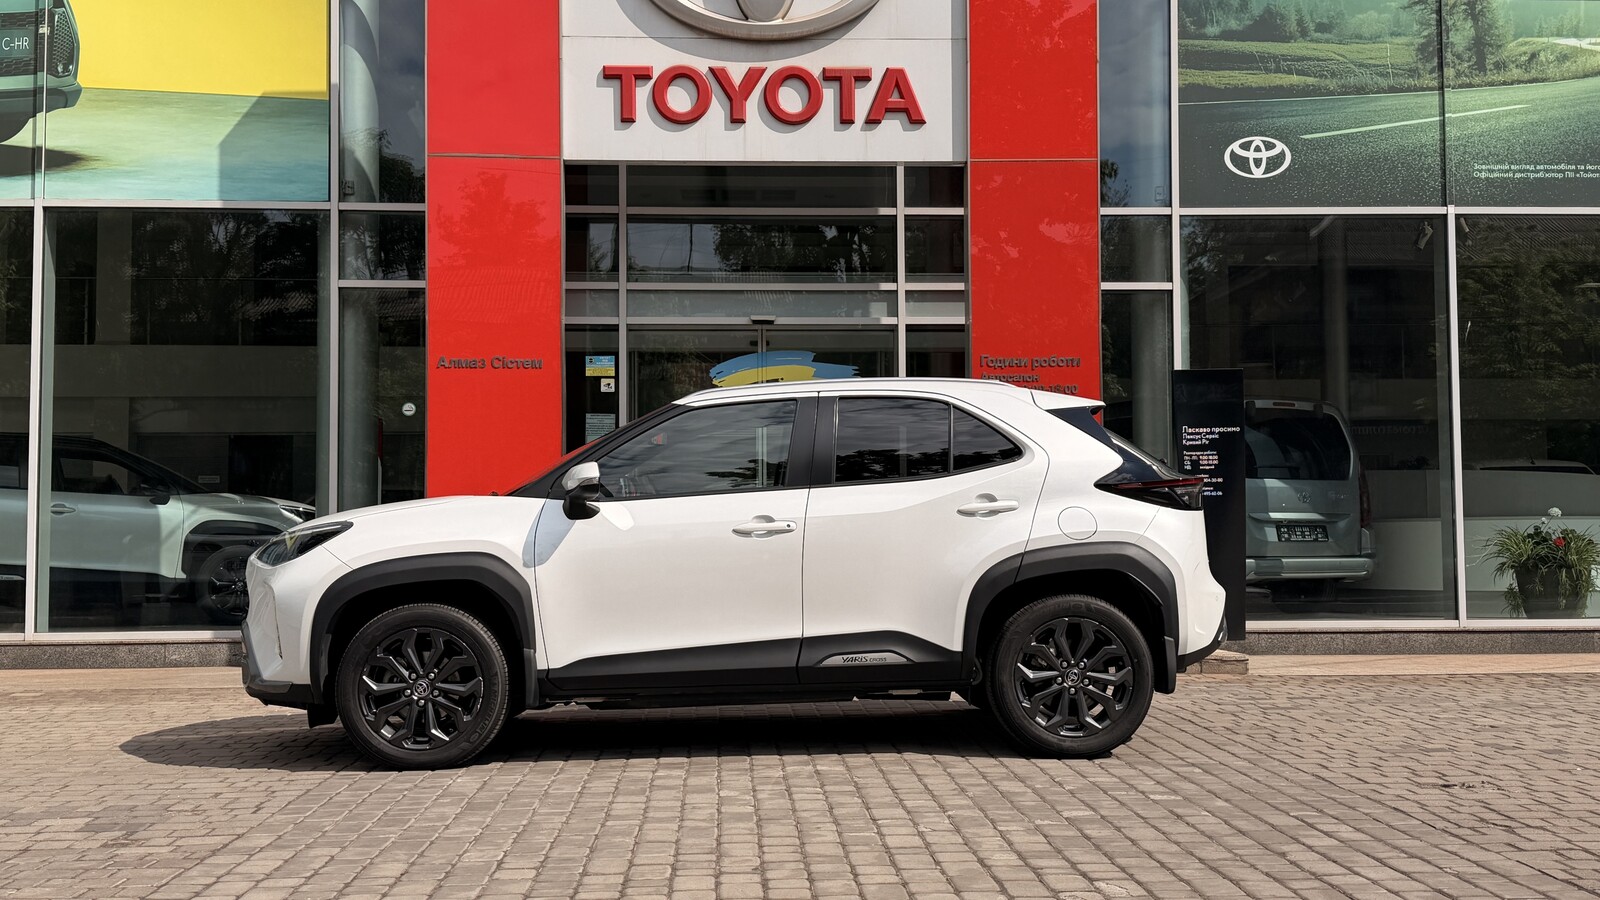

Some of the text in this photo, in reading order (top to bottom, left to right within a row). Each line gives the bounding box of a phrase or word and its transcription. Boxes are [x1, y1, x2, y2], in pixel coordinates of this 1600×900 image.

[2, 37, 29, 50] C-HR
[602, 64, 927, 125] TOYOTA
[436, 356, 544, 369] Алмаз Сістем
[980, 354, 1081, 371] Години роботи
[981, 372, 1040, 382] Автосалон
